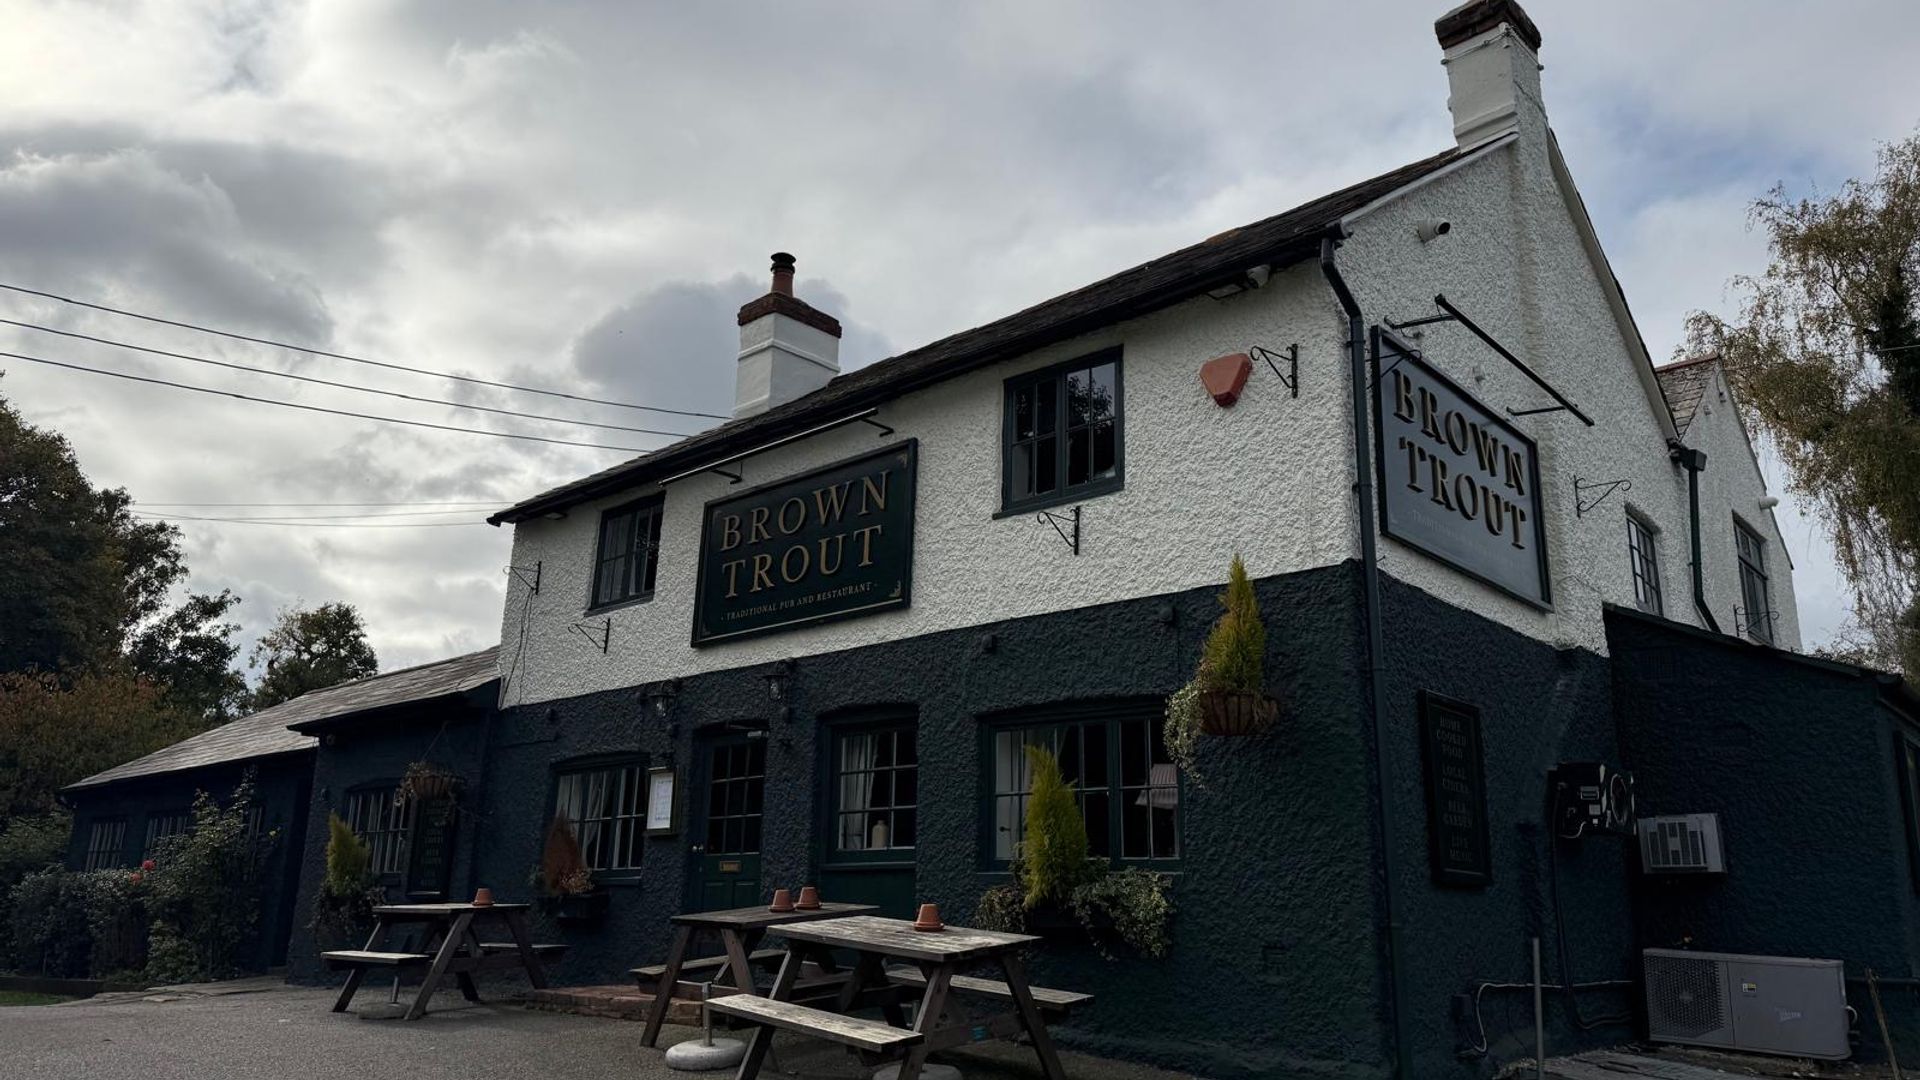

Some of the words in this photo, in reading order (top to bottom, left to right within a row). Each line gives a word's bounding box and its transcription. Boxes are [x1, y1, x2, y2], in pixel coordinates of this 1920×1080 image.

[1391, 368, 1525, 496] BROWN
[719, 470, 892, 551] BROWN
[1399, 436, 1527, 550] TROUT
[721, 524, 882, 599] TROUT
[726, 602, 777, 621] TRADITIONAL
[779, 599, 795, 610] PUB
[797, 594, 815, 605] AND
[816, 582, 872, 601] RESTAURANT
